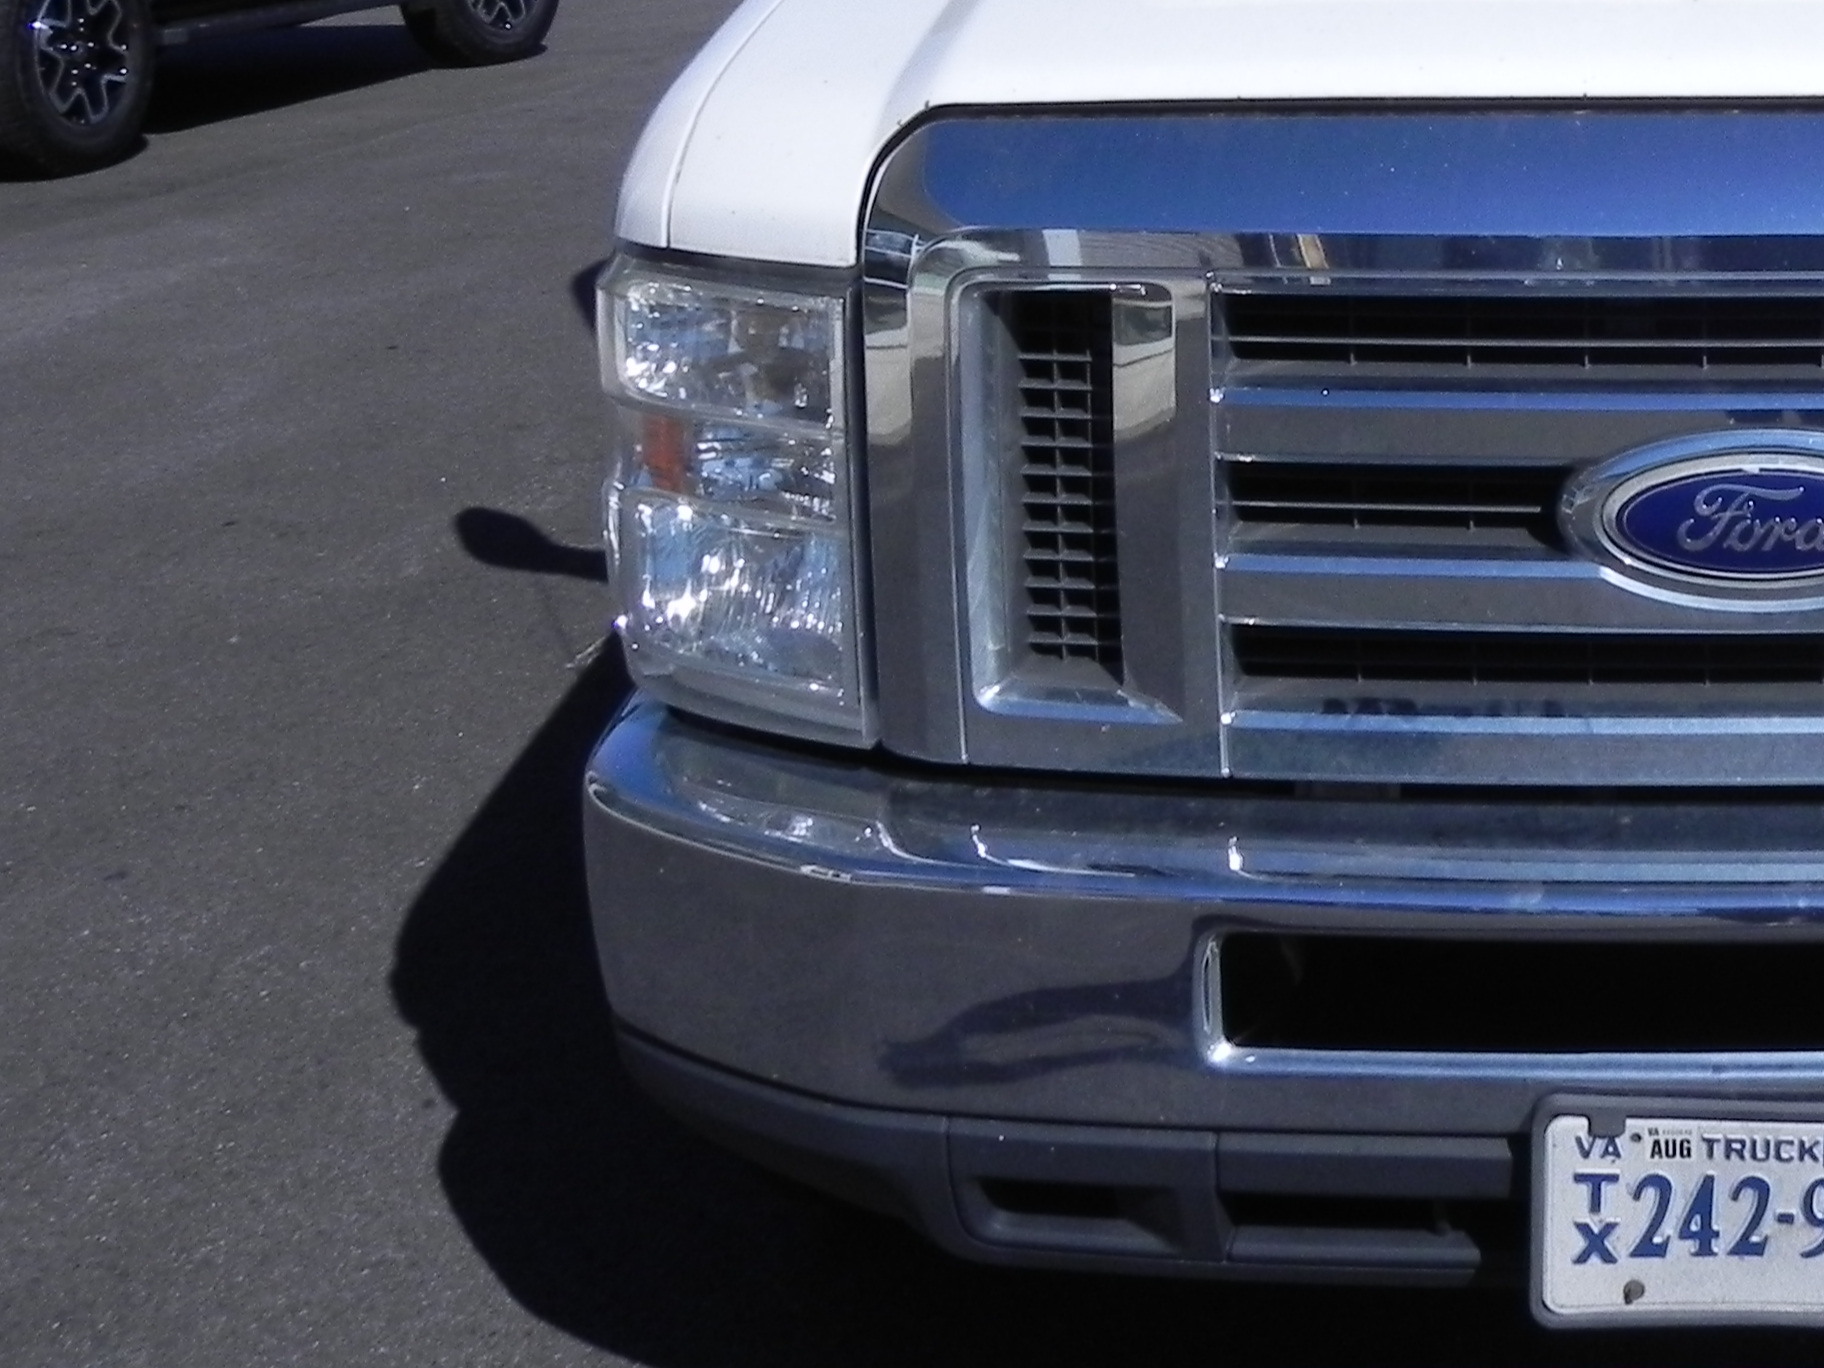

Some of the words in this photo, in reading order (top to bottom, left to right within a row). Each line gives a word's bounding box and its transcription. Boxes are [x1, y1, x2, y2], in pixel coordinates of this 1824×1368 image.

[1574, 1135, 1622, 1160] VA
[1701, 1135, 1820, 1163] TRUCK
[1650, 1138, 1692, 1160] AUG
